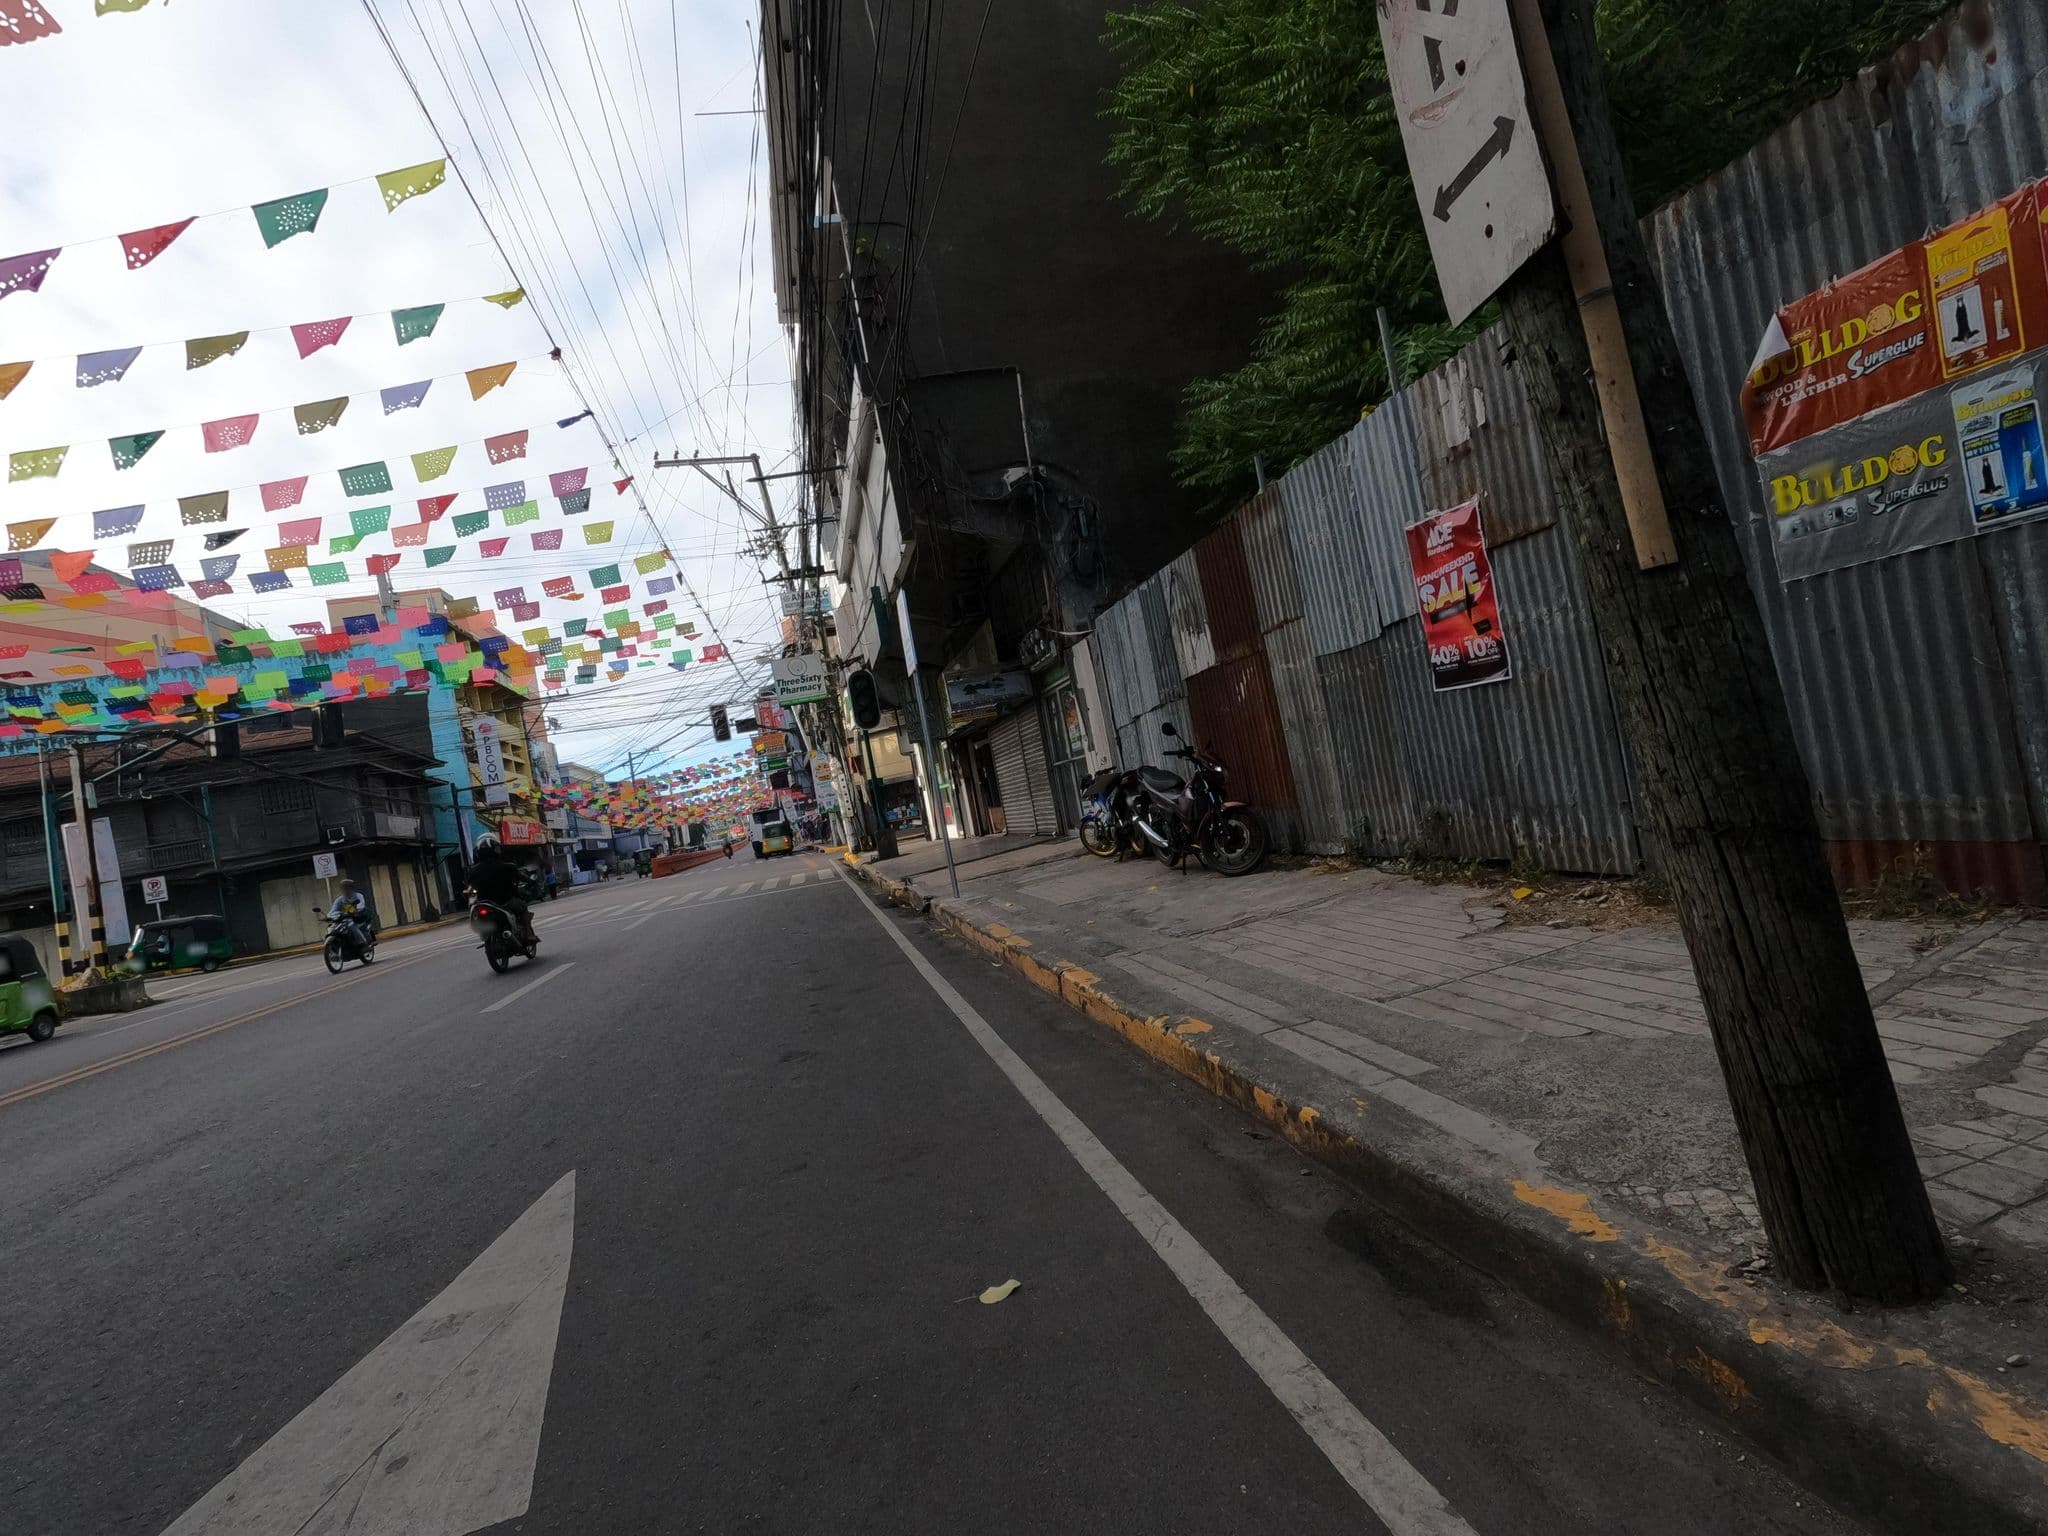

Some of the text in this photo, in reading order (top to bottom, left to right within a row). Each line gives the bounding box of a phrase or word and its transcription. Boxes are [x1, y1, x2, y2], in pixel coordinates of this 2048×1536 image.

[1847, 332, 1925, 379] SUPERGLUE
[1781, 373, 1848, 407] LEATHER
[1807, 374, 1817, 385] &
[1770, 434, 1946, 516] BULLDOG
[1866, 477, 1949, 516] SUPERGLUE
[1427, 521, 1453, 548] ACE
[1419, 561, 1481, 613] SALE
[1431, 644, 1460, 666] 40%
[1464, 636, 1497, 659] 10%
[780, 683, 822, 695] Pharmacy
[483, 736, 499, 783] PBCOM
